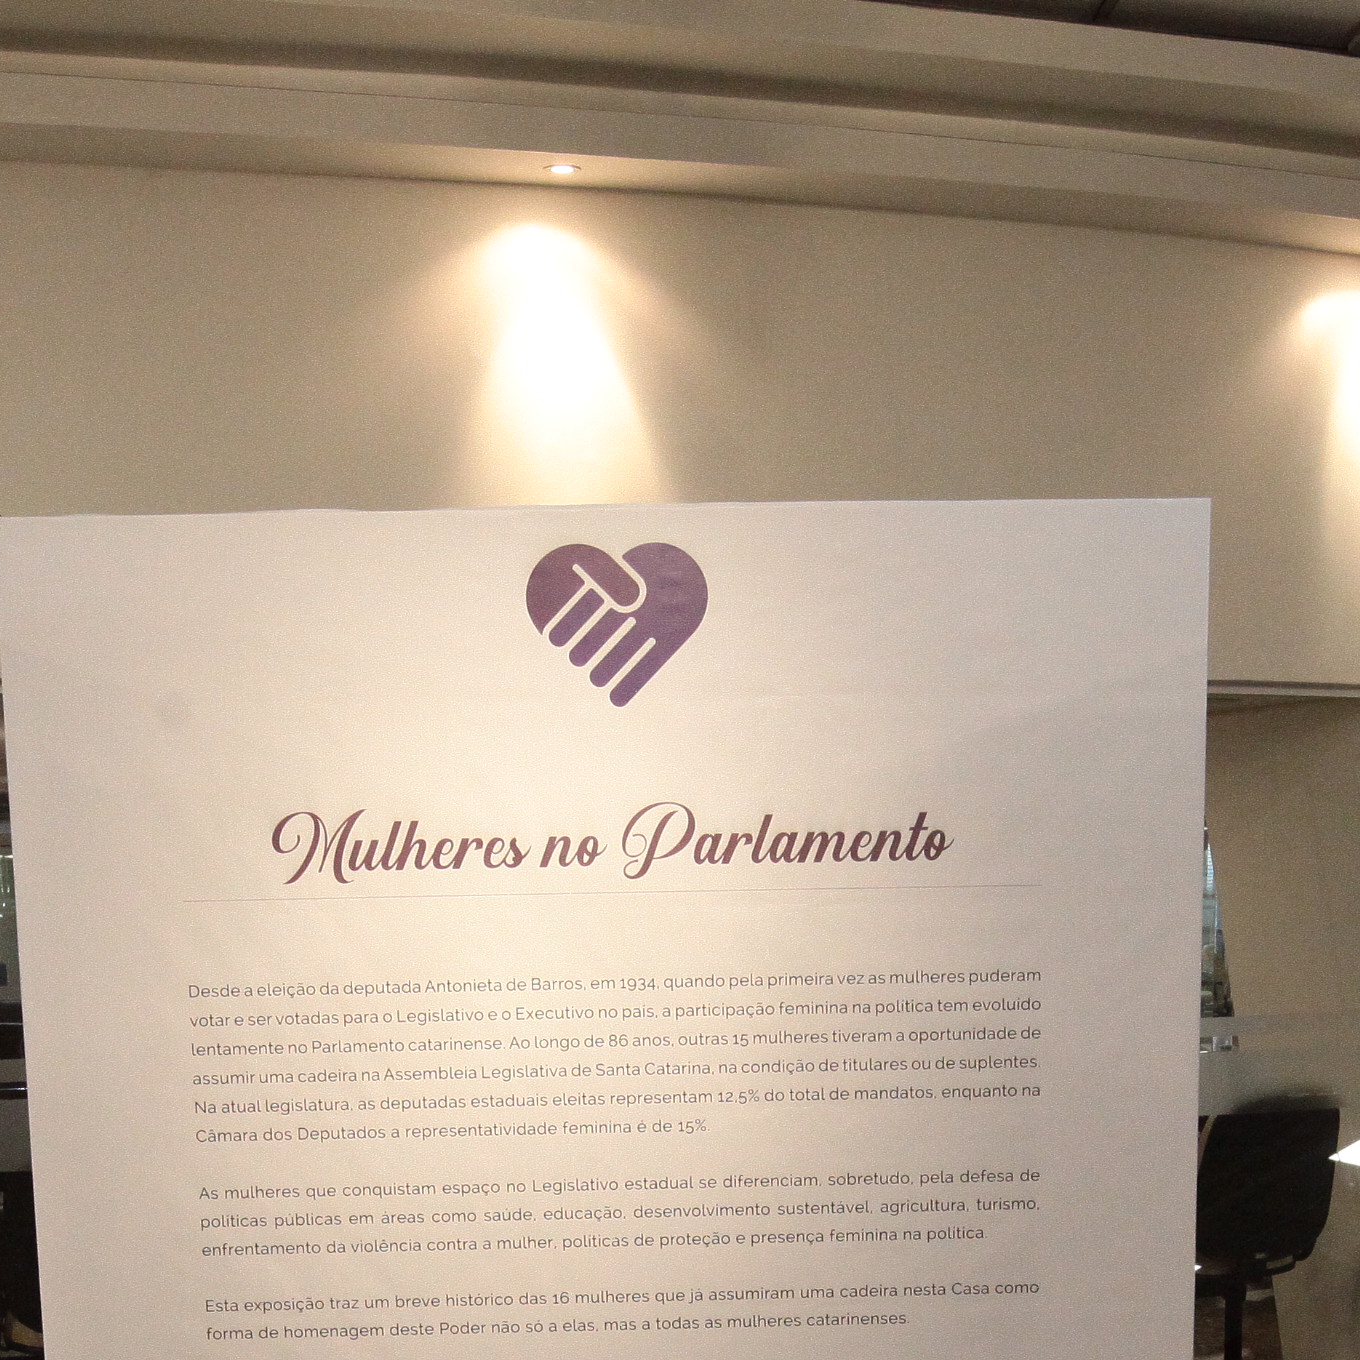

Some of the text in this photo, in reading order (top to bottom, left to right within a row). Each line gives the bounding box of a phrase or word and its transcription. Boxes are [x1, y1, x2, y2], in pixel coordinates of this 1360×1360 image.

[271, 802, 955, 885] Mulheres no Parlamento
[188, 968, 1041, 999] Desde a eleição da deputada Antonieta de Barros, em 1934, quando pela primeira vez as mulheres puderam
[194, 1100, 216, 1114] Na
[221, 1100, 261, 1114] atual
[358, 1099, 375, 1110] as
[380, 1095, 466, 1112] deputadas
[470, 1094, 548, 1108] estaduais
[552, 1092, 605, 1106] eleitas
[610, 1090, 712, 1107] representam
[717, 1088, 760, 1104] 12,5%
[763, 1088, 784, 1102] do
[789, 1086, 826, 1101] total
[828, 1086, 850, 1101] de
[853, 1086, 936, 1100] mandatos,
[940, 1083, 1018, 1101] enquanto
[1021, 1085, 1041, 1097] na
[200, 1214, 267, 1231] políticas
[274, 1212, 342, 1229] públicas
[348, 1213, 374, 1224] em
[380, 1212, 424, 1224] áreas
[431, 1211, 476, 1223] como
[484, 1207, 536, 1222] saúde,
[633, 1203, 770, 1219] desenvolvimento
[880, 1198, 969, 1216] agricultura,
[976, 1197, 1040, 1211] turismo,
